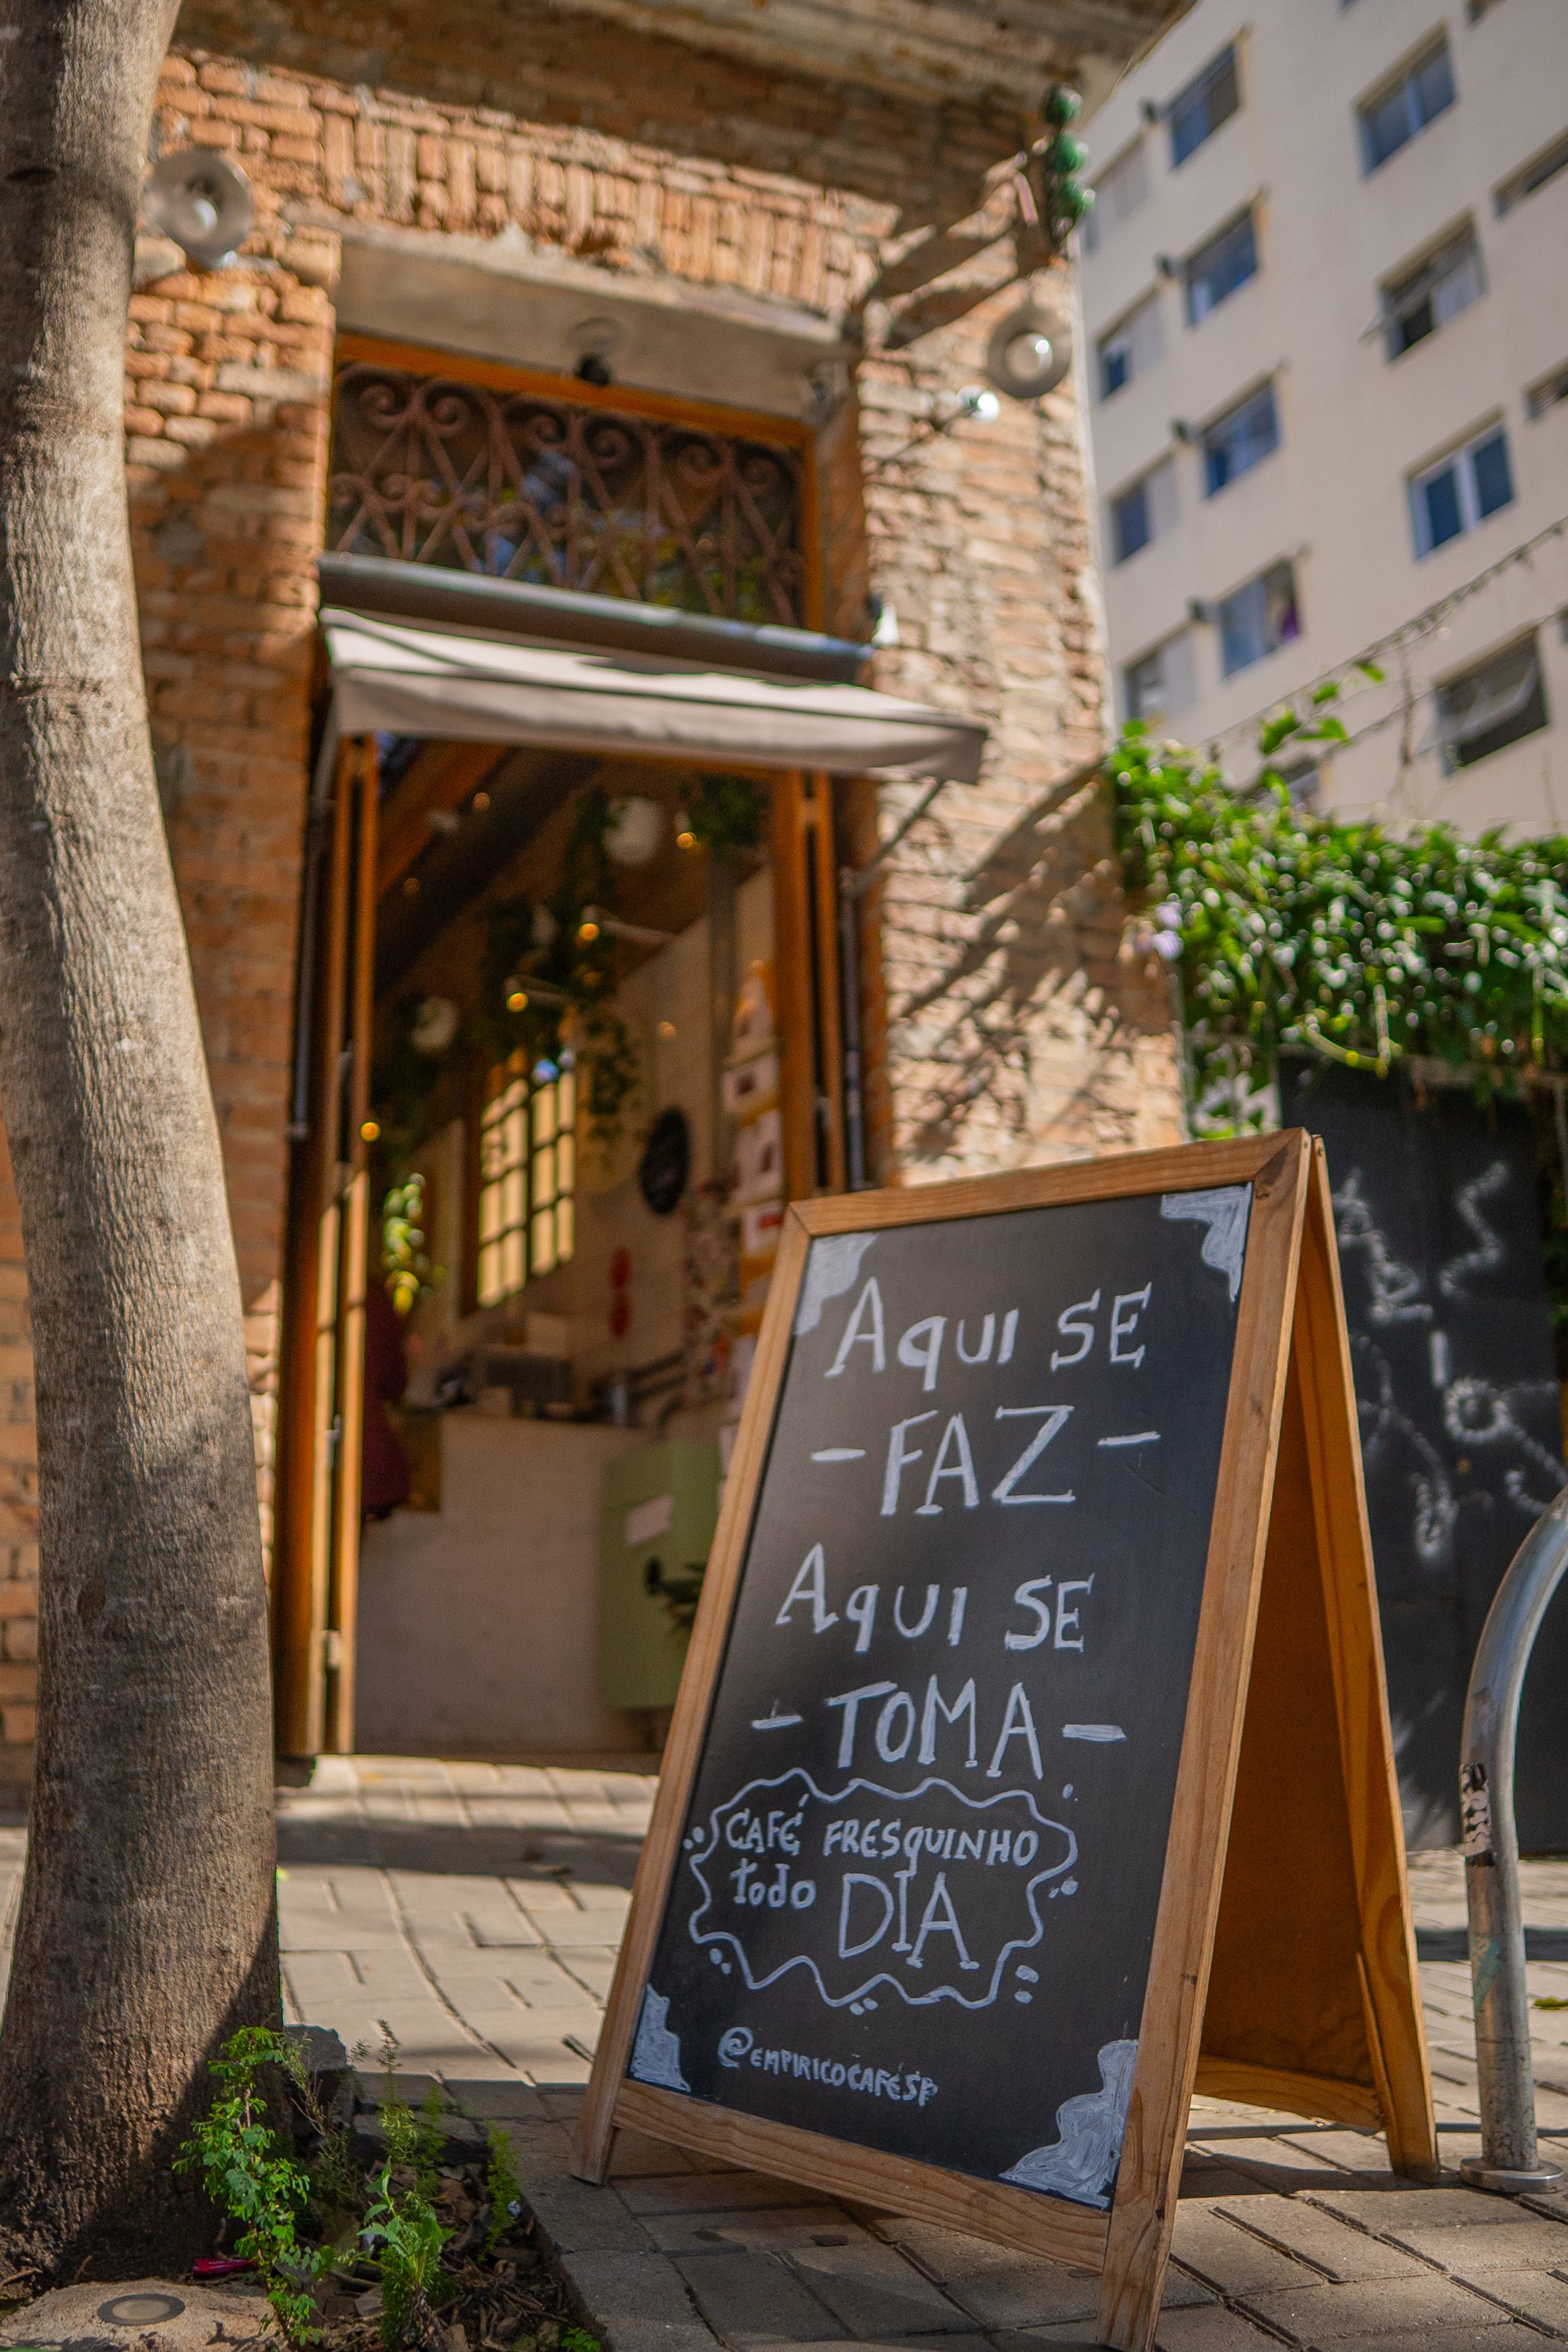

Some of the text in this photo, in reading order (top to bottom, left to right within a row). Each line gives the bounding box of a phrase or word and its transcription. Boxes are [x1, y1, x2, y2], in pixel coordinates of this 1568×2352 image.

[1051, 1282, 1152, 1371] SE
[880, 1404, 1076, 1516] FAZ
[1005, 1572, 1095, 1652] SE
[824, 1674, 1043, 1779] TOMA
[726, 1793, 810, 1856] CAFÉ
[837, 1871, 979, 1968] DIA
